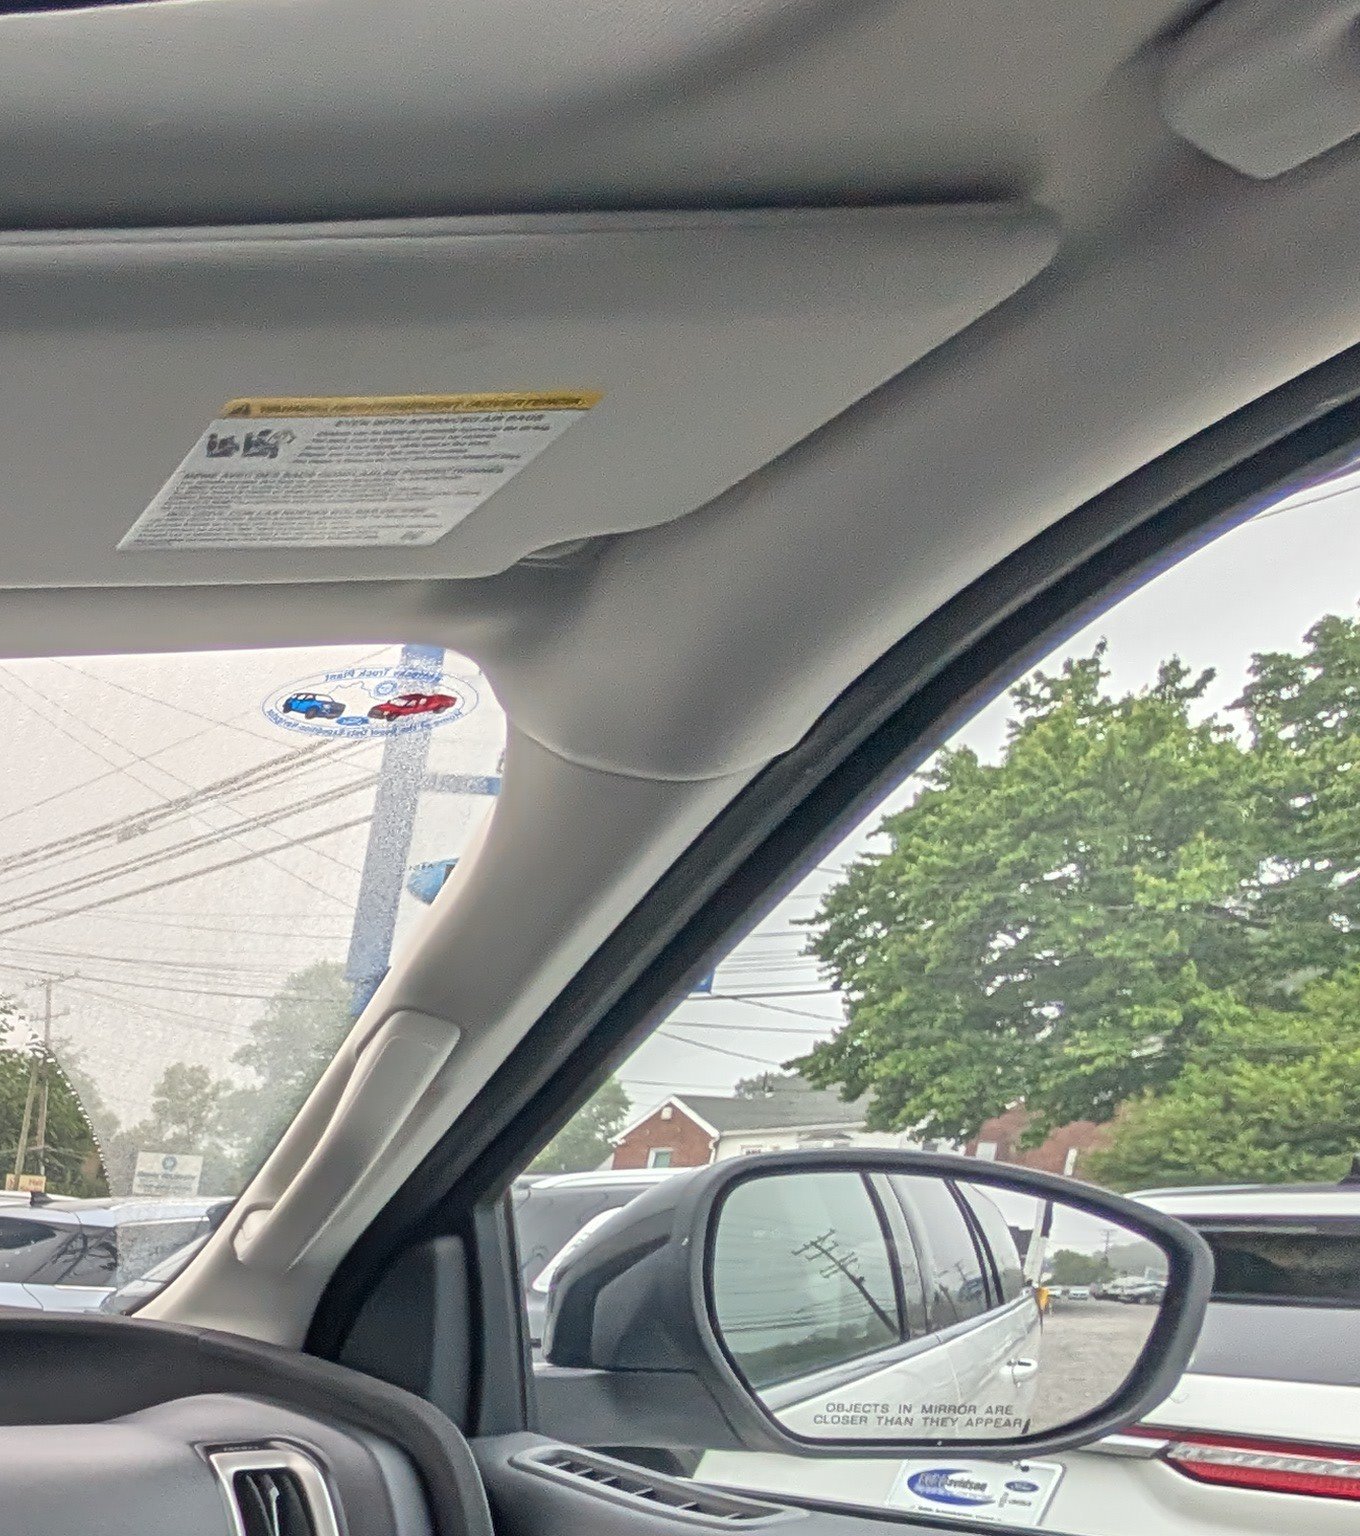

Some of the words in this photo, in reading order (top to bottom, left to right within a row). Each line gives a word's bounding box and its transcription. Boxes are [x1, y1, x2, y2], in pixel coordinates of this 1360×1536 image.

[825, 1402, 890, 1415] OBJECTS
[898, 1402, 913, 1415] IN
[921, 1403, 977, 1415] MIRROR
[984, 1404, 1014, 1416] ARE
[813, 1413, 869, 1426] CLOSER
[877, 1415, 914, 1427] THAN
[921, 1416, 959, 1428] THEY
[964, 1416, 1023, 1429] APPEAR
